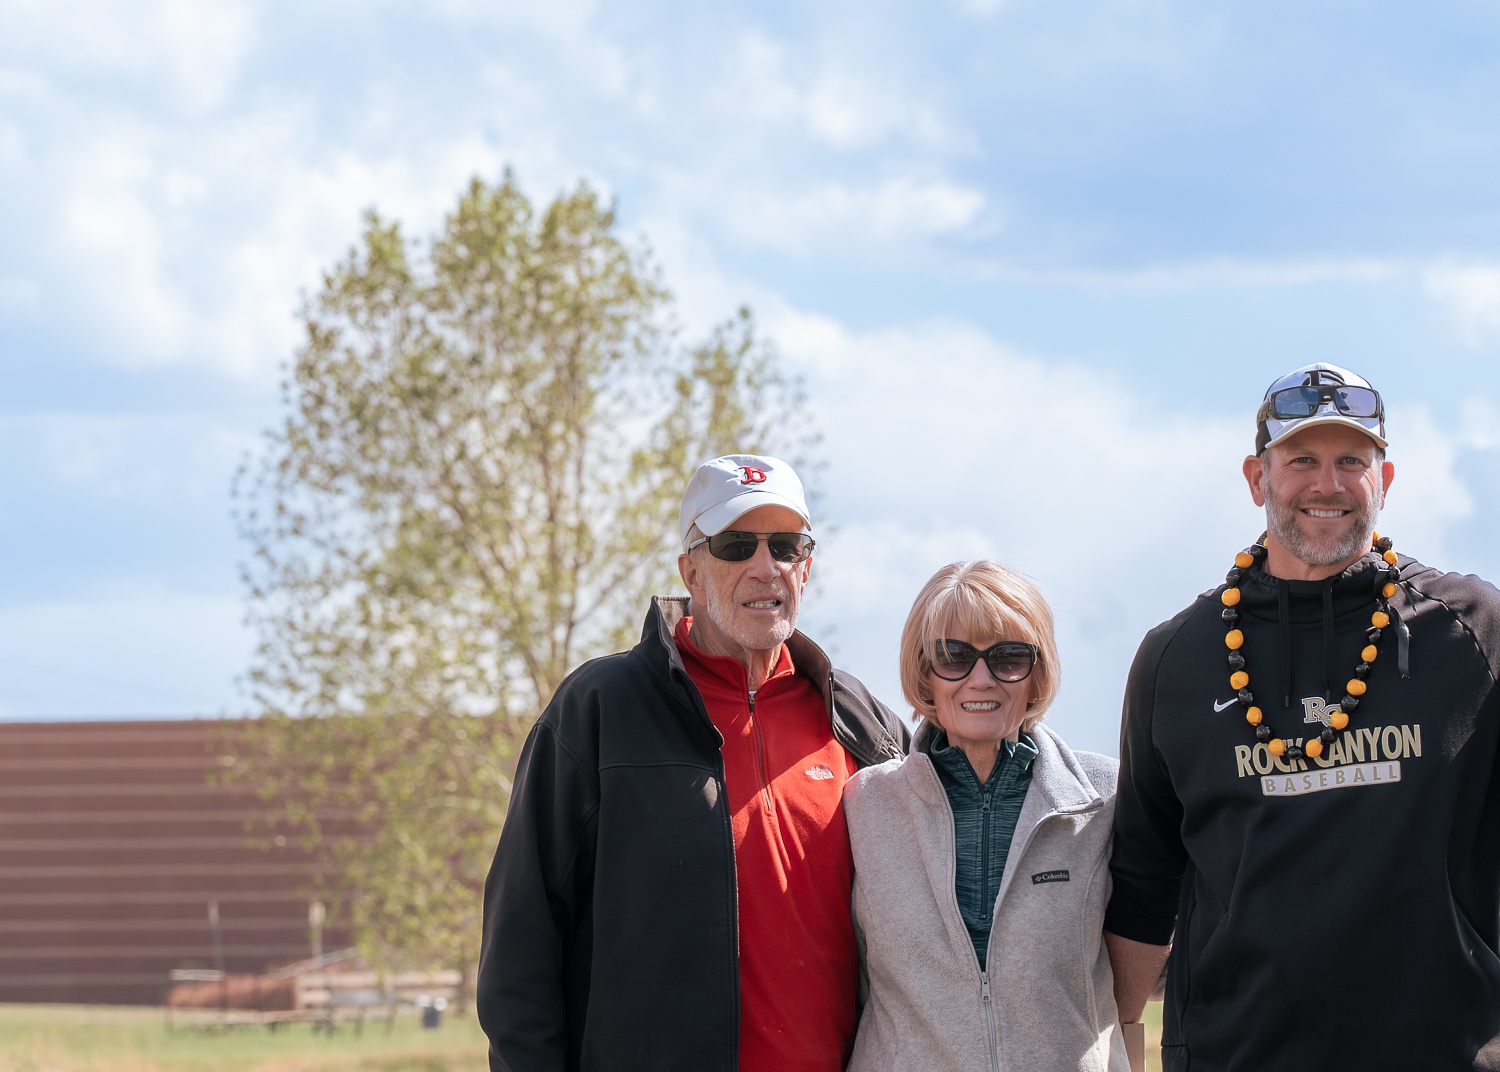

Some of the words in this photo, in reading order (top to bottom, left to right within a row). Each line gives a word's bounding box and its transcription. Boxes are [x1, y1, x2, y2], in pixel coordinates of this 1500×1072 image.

[1235, 737, 1309, 778] ROCK
[1264, 764, 1398, 793] BASEBALL
[1042, 872, 1068, 881] Columbia
